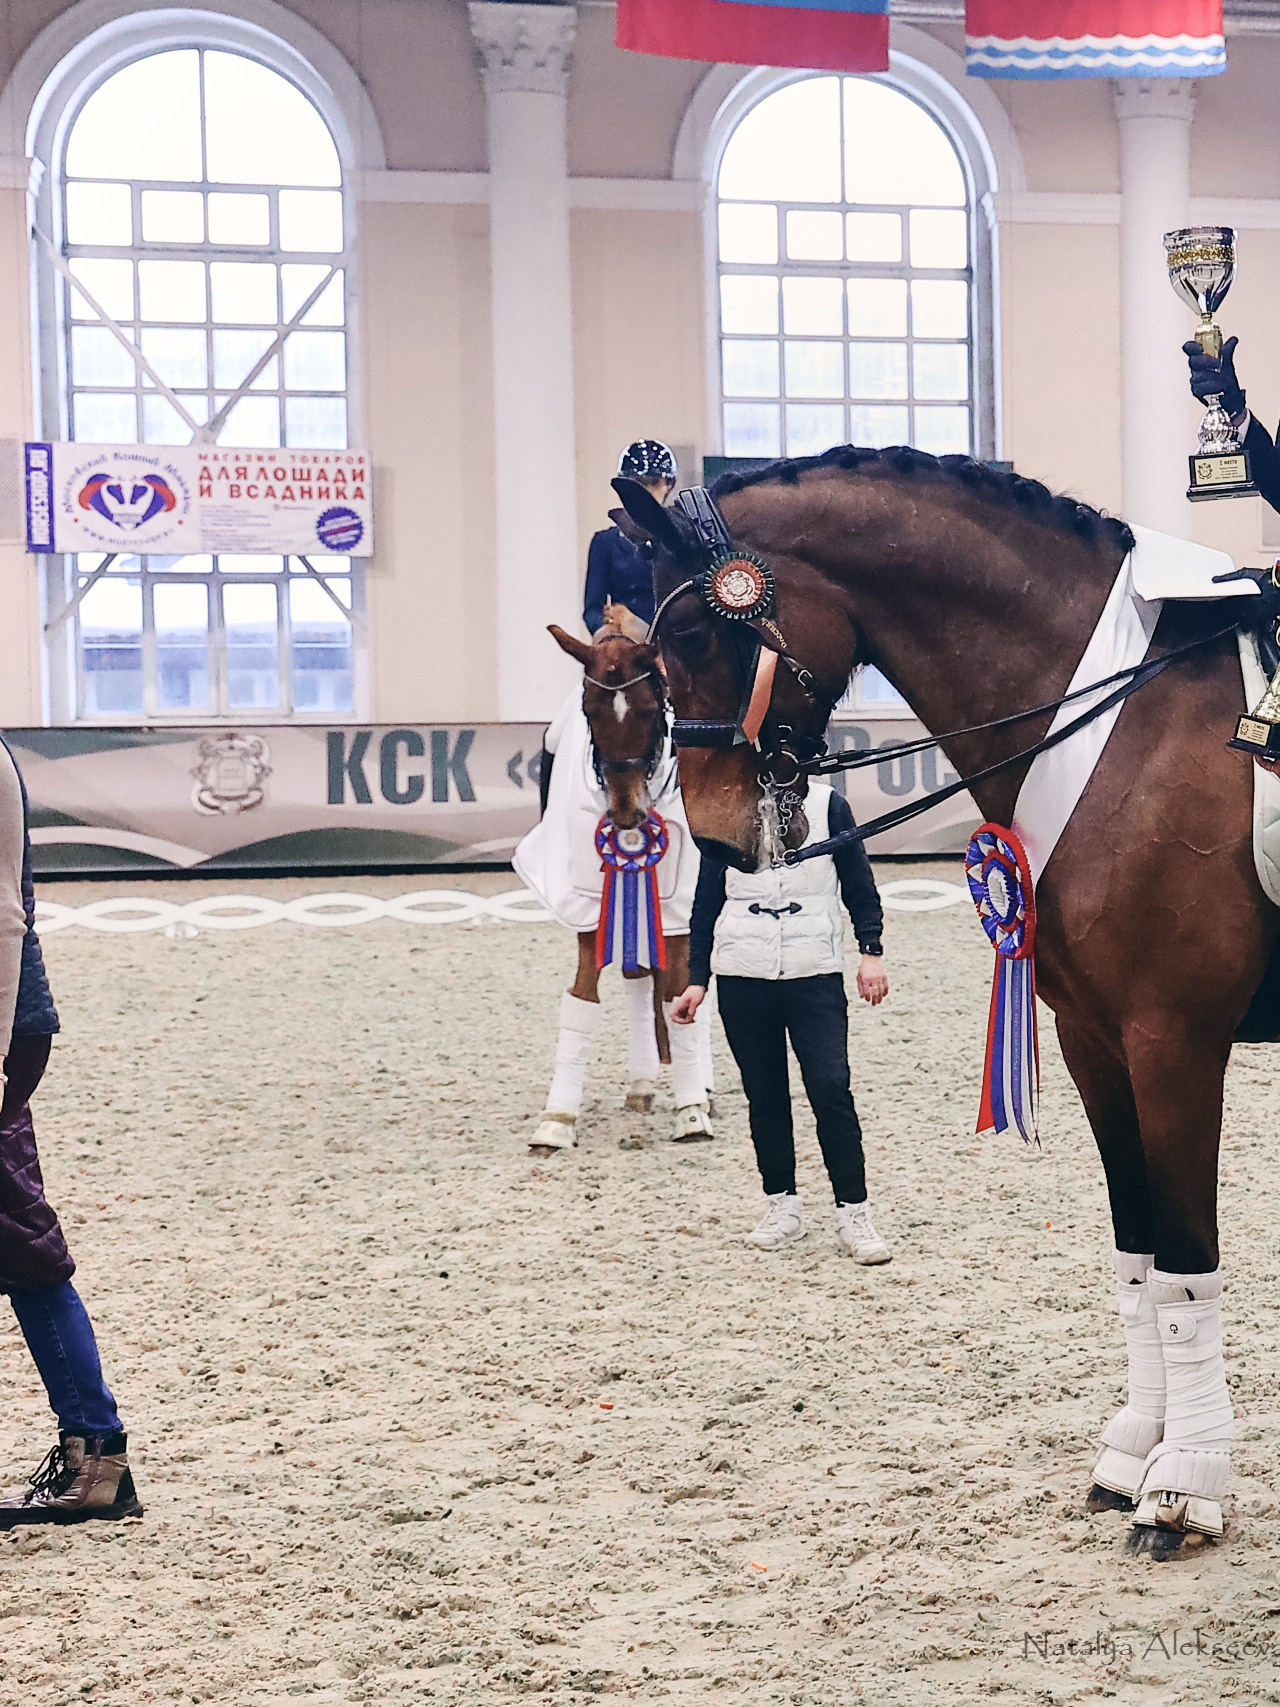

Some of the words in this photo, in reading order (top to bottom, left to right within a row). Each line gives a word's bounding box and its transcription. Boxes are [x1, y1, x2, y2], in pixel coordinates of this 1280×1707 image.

[199, 466, 248, 482] ДЛЯ
[256, 467, 365, 484] ЛОШАДИ
[199, 484, 213, 498] И
[229, 484, 365, 501] ВСАДНИКА
[327, 729, 477, 805] КСК
